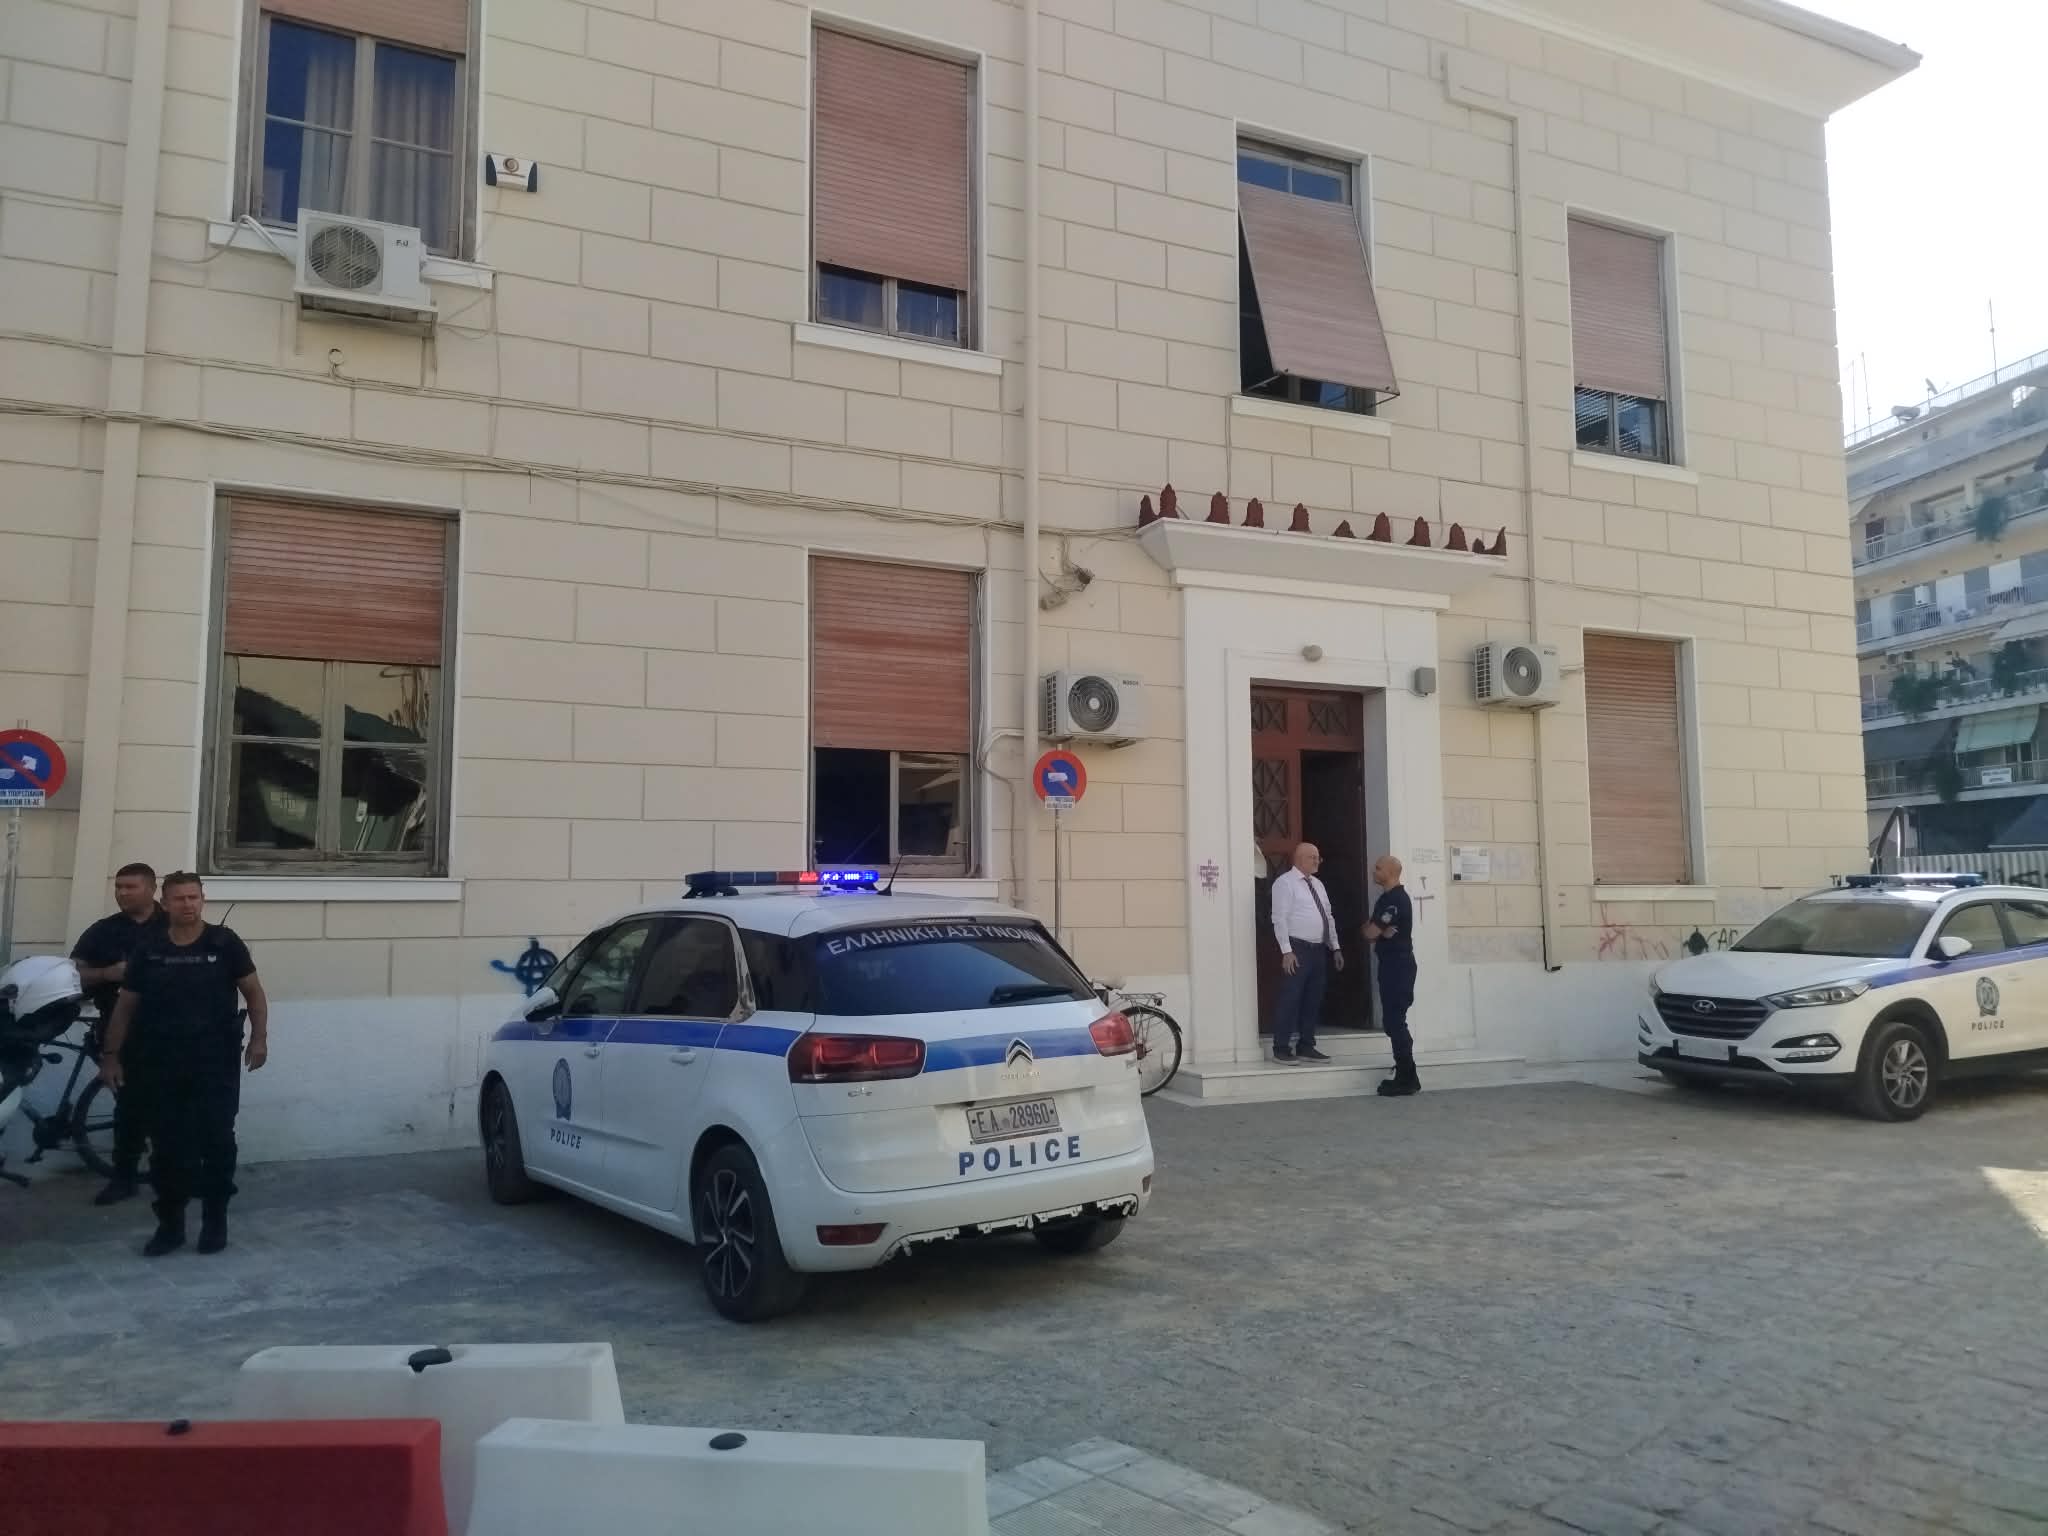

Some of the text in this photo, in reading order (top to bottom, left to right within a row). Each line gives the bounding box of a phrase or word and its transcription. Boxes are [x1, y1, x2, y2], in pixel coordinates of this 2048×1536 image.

[826, 926, 943, 955] ΕΛΛΗΝΙΚΗ
[1971, 1020, 2005, 1031] POLICE
[1009, 1102, 1050, 1129] 28960
[551, 1128, 581, 1149] POLICE
[959, 1135, 1081, 1176] POLICE
